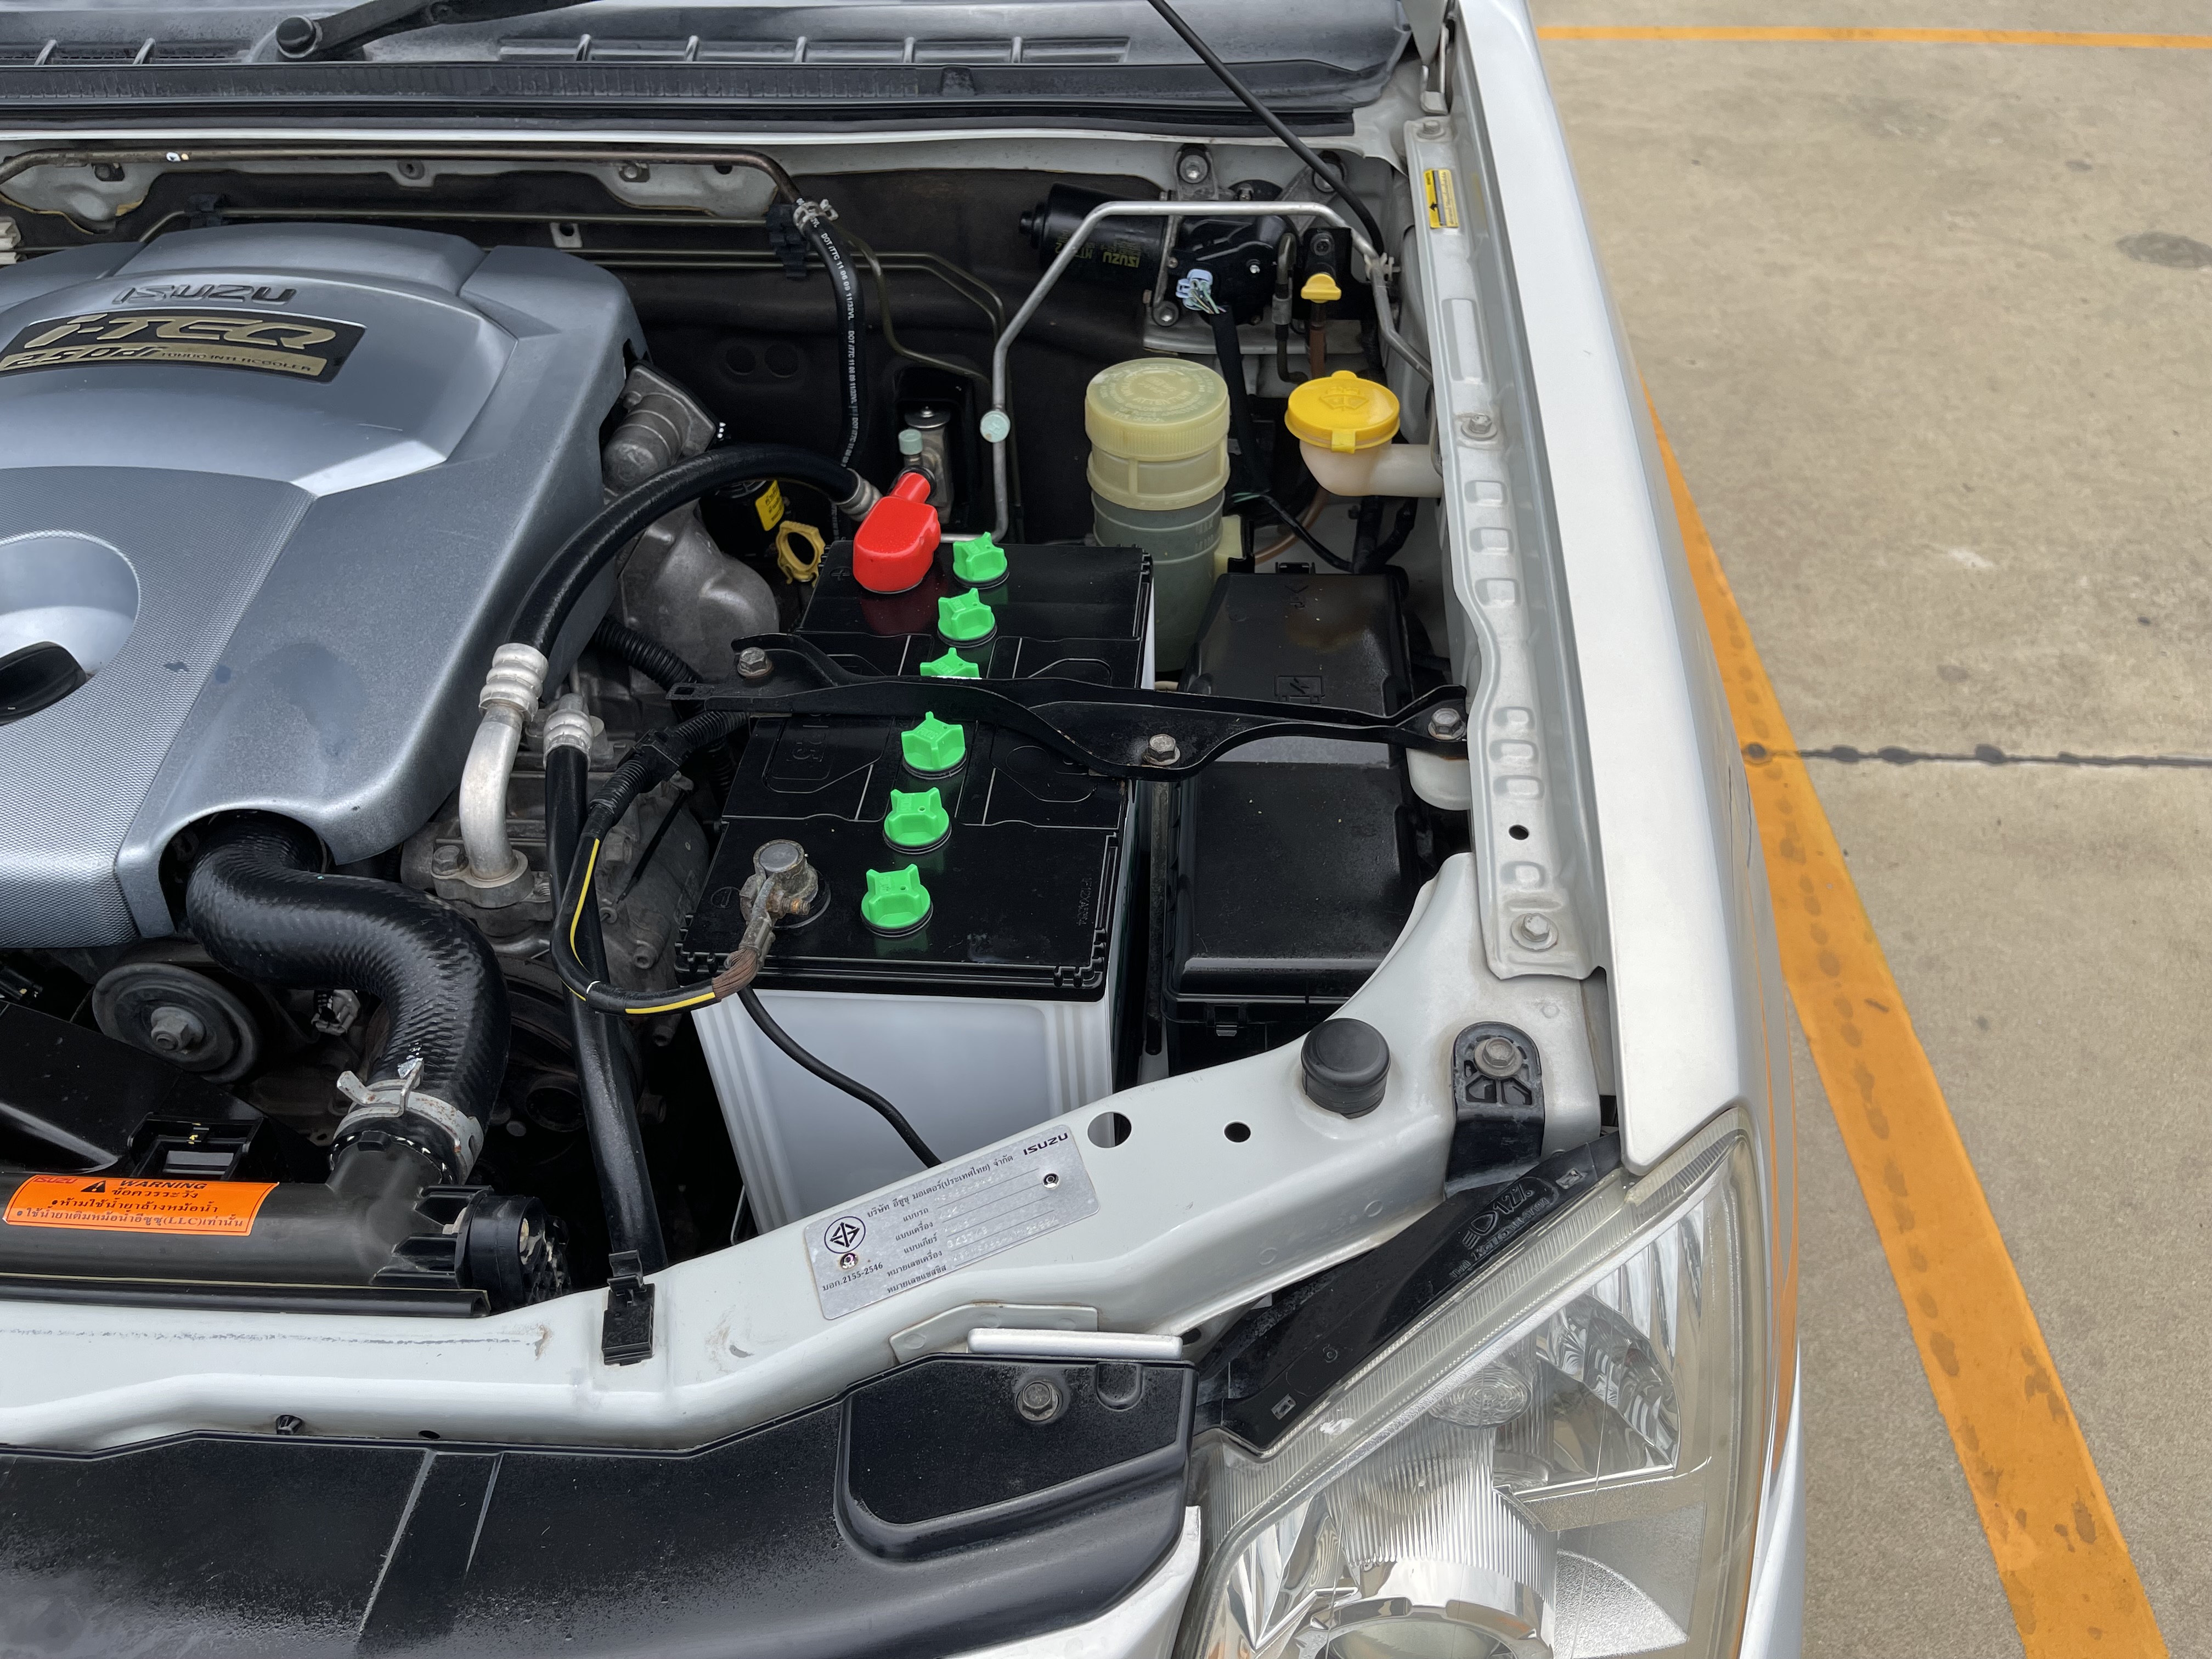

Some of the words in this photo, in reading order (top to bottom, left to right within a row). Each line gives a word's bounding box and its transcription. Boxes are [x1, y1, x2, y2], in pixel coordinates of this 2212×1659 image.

[1103, 251, 1140, 268] ISUZU
[112, 284, 298, 305] ISUZU
[1132, 390, 1193, 405] ATTENTION
[1023, 1132, 1068, 1155] ISUZU
[111, 1187, 199, 1199] ข้อควรระวัง
[120, 1180, 207, 1189] WARNING
[867, 1202, 890, 1218] บริษัท
[902, 1206, 929, 1223] แบบรถ
[822, 1261, 884, 1291] มอก.2155-2546
